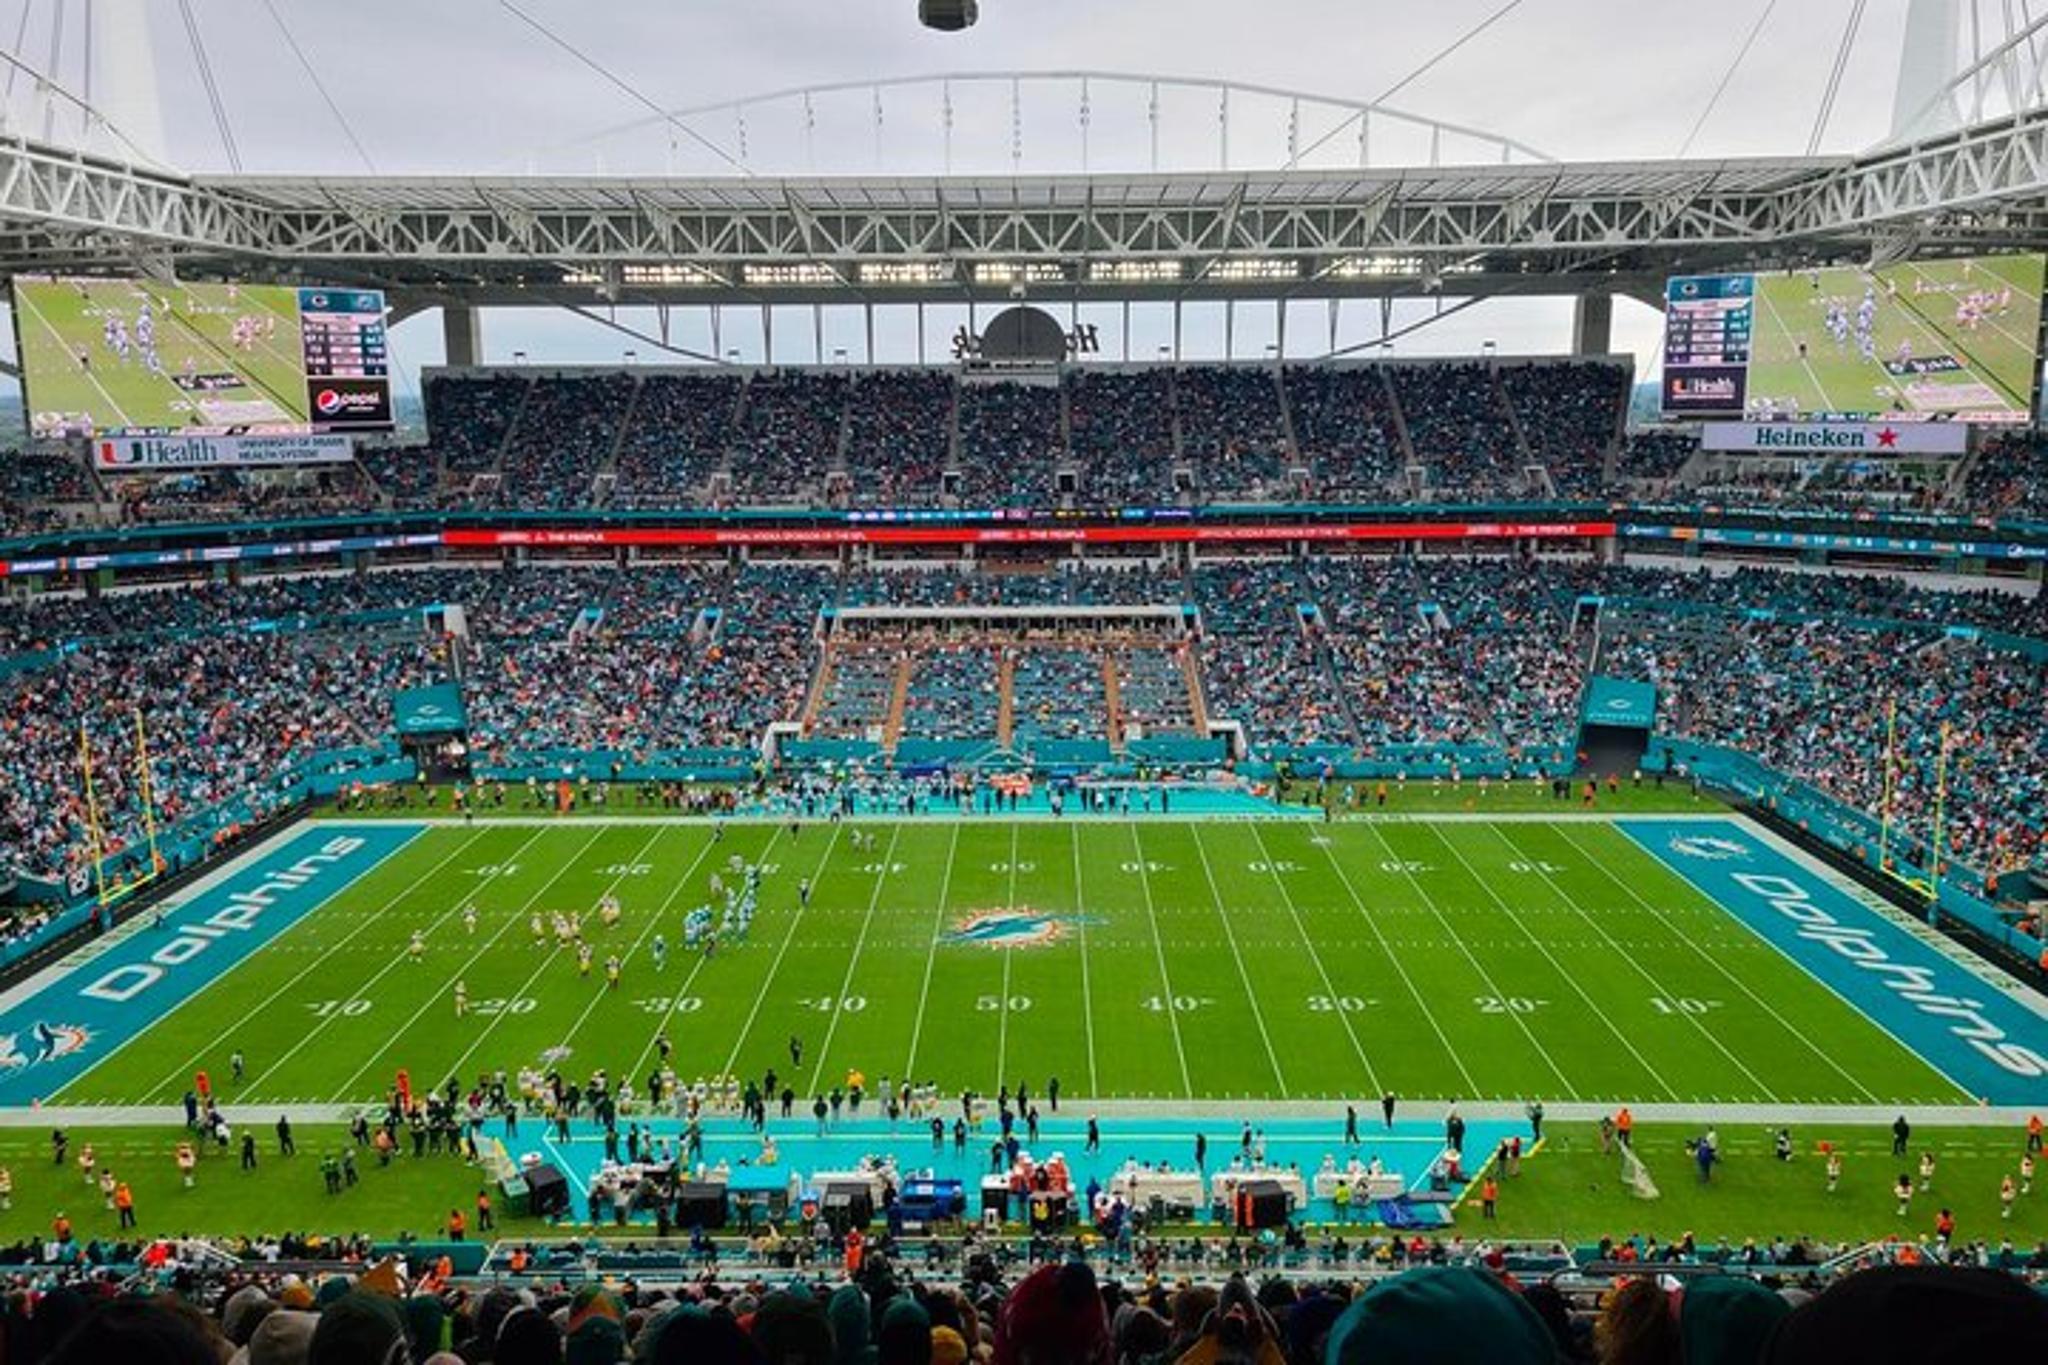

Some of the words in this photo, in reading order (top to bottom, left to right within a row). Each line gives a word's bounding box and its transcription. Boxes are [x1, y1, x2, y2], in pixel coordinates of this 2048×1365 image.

[1755, 426, 1865, 447] Heineken
[78, 834, 367, 1002] Dolphins
[1729, 872, 2048, 1077] Dolphins
[316, 1000, 372, 1016] 10
[477, 999, 540, 1015] 20
[642, 998, 703, 1013] 30
[817, 997, 867, 1012] 40
[976, 995, 1032, 1011] 50
[1141, 995, 1198, 1011] 40
[1306, 996, 1366, 1012] 30
[1474, 996, 1536, 1013] 20
[1649, 997, 1710, 1014] 10
